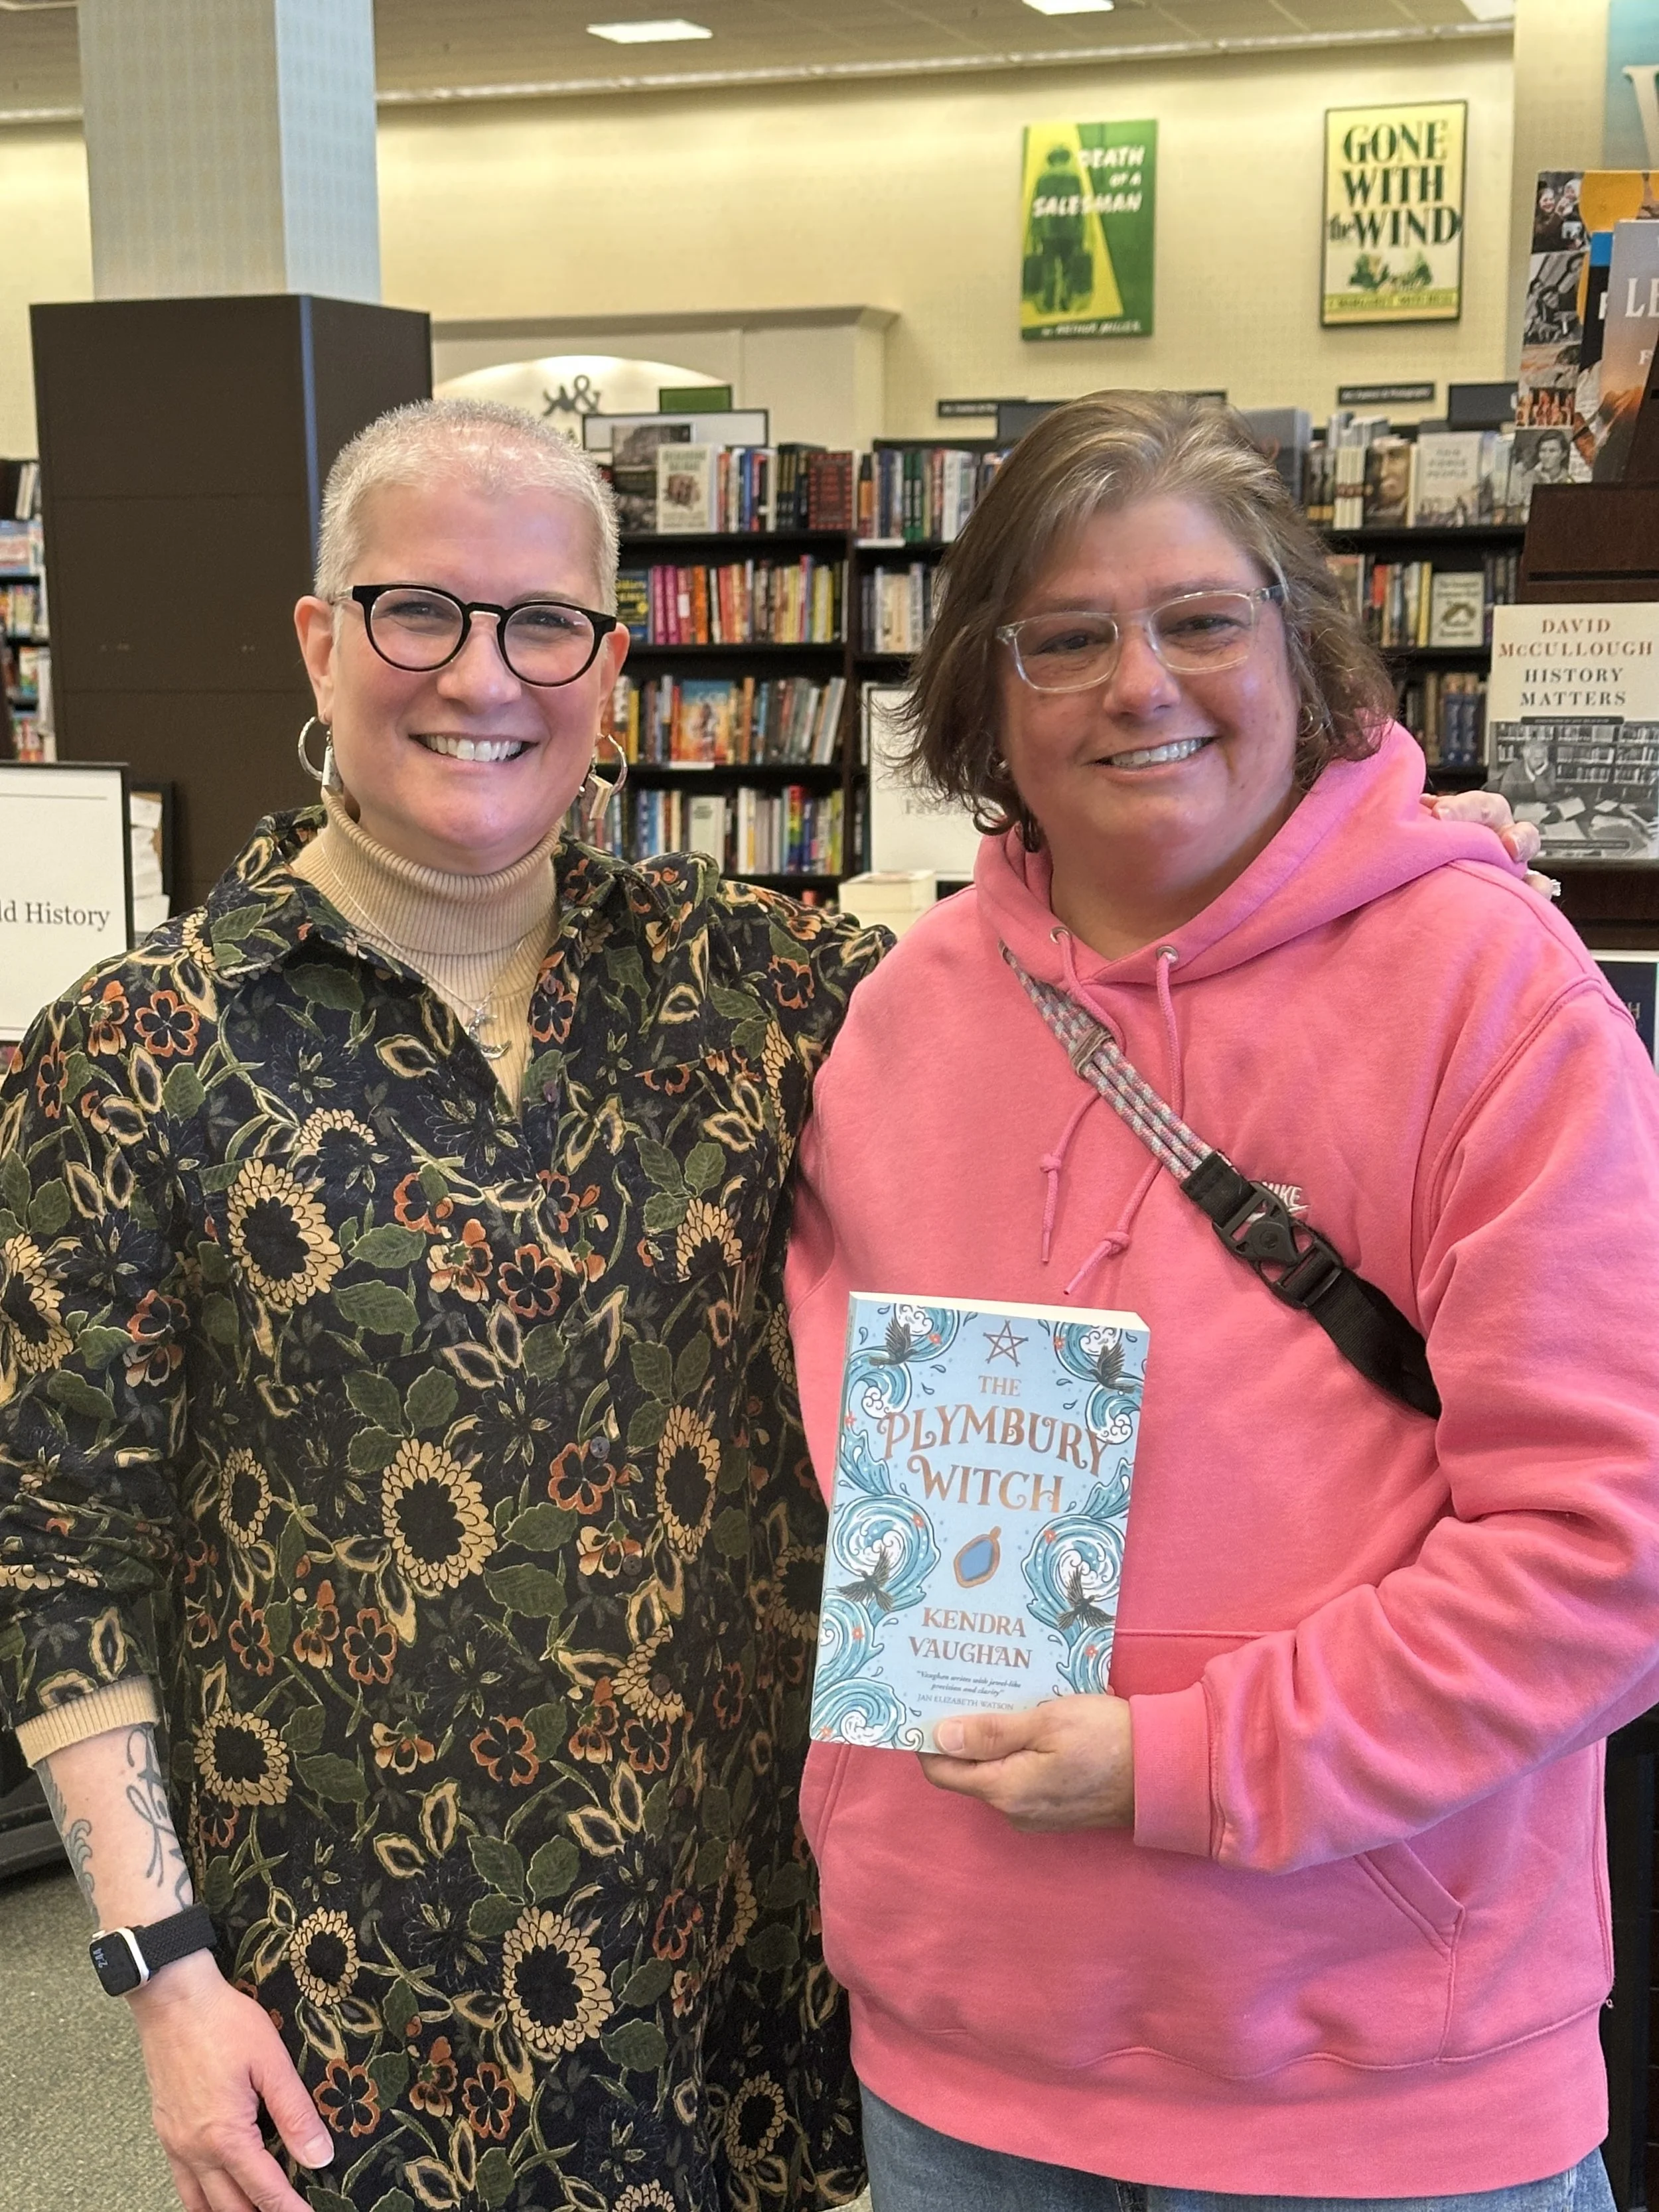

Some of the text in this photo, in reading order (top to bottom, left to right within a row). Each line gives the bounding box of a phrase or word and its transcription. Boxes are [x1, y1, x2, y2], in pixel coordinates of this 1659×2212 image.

[1342, 119, 1448, 164] GONE
[1080, 145, 1145, 169] DEATH
[1342, 165, 1445, 207] WITH
[1033, 190, 1143, 218] SALESMAN
[1328, 205, 1462, 249] the WIND
[1541, 618, 1612, 635] DAVID
[1496, 640, 1654, 659] McCULLOUGH
[1524, 667, 1624, 684] HISTORY
[1520, 691, 1626, 707] MATTERS
[25, 900, 111, 932] History
[1262, 1181, 1303, 1207] IKE
[978, 1375, 1022, 1397] THE
[877, 1403, 1113, 1478] PLYMBURY
[907, 1454, 1064, 1513] WITCH
[921, 1607, 1027, 1637] KENDRA
[908, 1635, 1033, 1669] VAUGHAN
[930, 1683, 962, 1691] precision
[973, 1677, 988, 1686] with
[917, 1693, 1014, 1710] JAN ELIZABETH WATSON
[94, 1947, 108, 1969] 2:44
